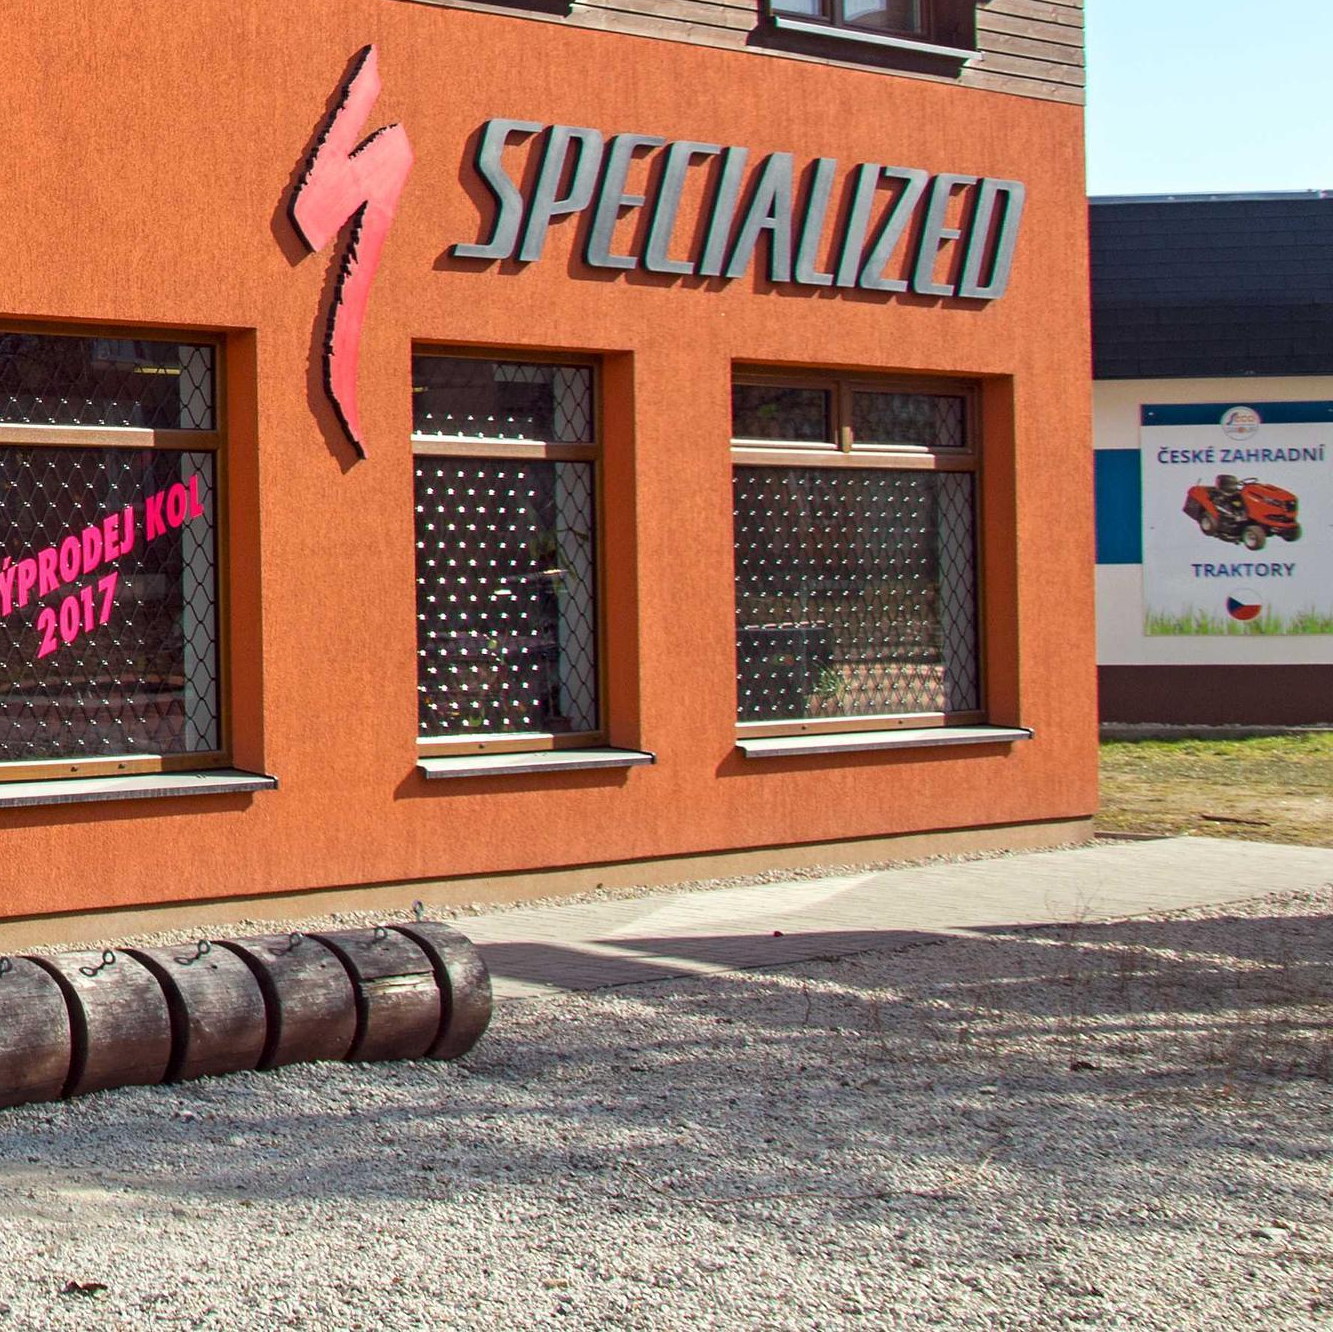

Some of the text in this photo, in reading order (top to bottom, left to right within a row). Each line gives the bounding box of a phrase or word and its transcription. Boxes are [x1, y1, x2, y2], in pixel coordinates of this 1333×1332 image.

[451, 117, 1026, 300] SPECIALIZED
[1157, 443, 1326, 464] ČESKÉ ZAHRADNÍ
[145, 474, 205, 542] KOL
[1191, 562, 1296, 578] TRAKTORY
[36, 571, 119, 659] 2017
